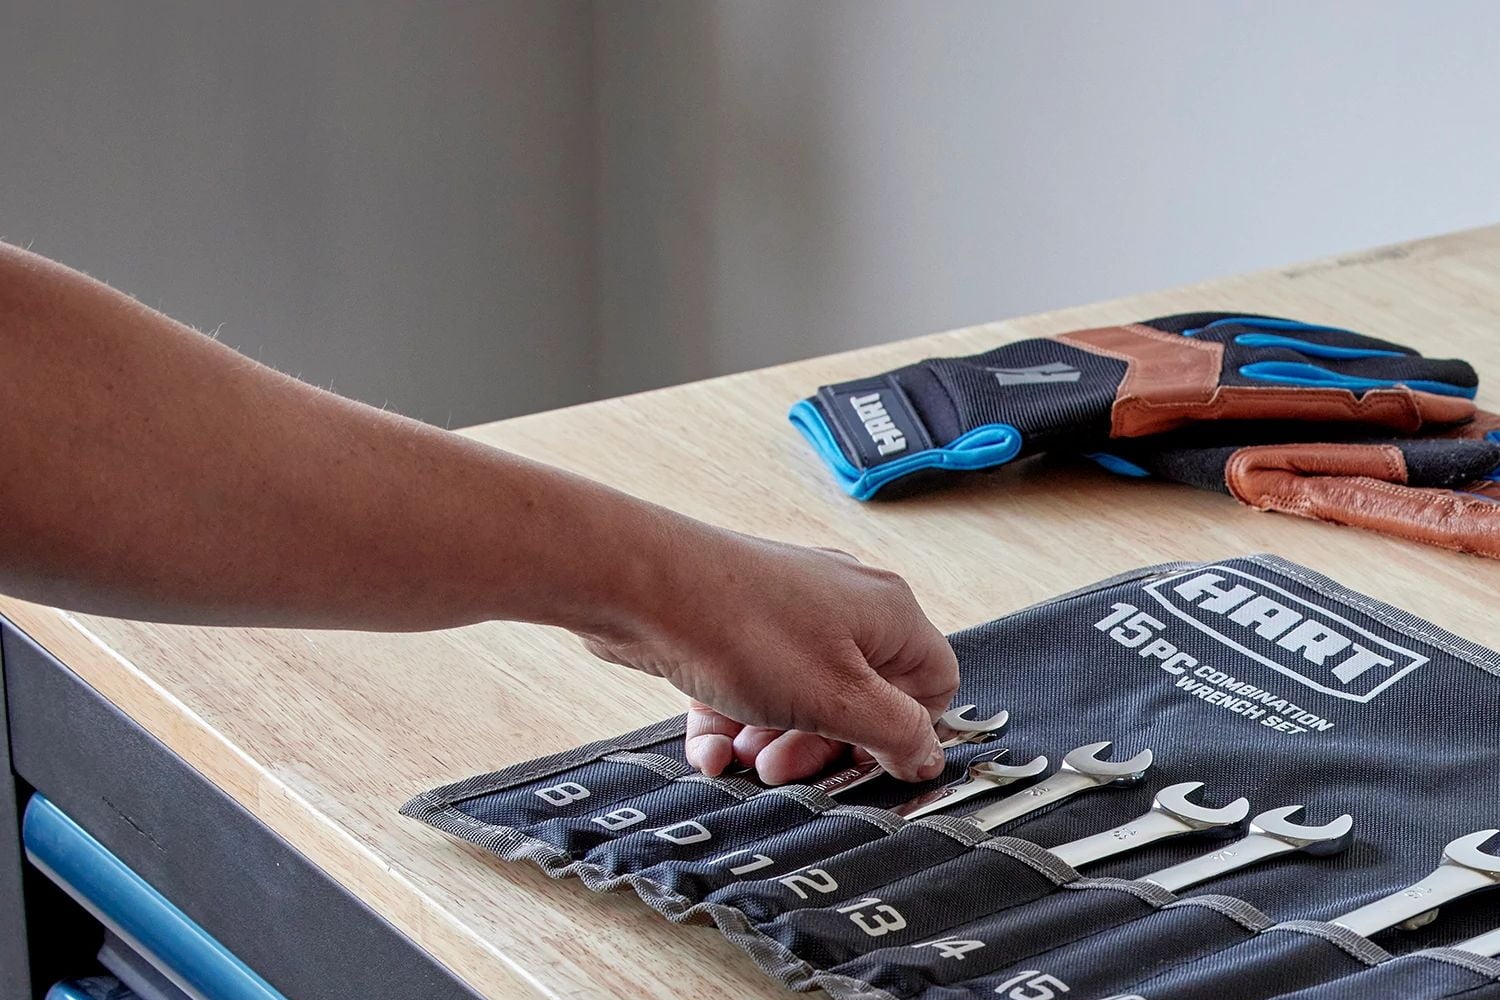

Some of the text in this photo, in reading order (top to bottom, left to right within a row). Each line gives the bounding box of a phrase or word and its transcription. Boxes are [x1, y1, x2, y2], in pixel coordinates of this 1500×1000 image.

[850, 392, 907, 457] HART
[1093, 602, 1198, 675] 15 PC
[1173, 572, 1395, 685] HART
[1175, 676, 1309, 735] WRENCH SET
[1195, 665, 1335, 731] COMBINATION
[533, 781, 591, 807] 8
[591, 807, 647, 831] 9
[836, 897, 907, 937] 13
